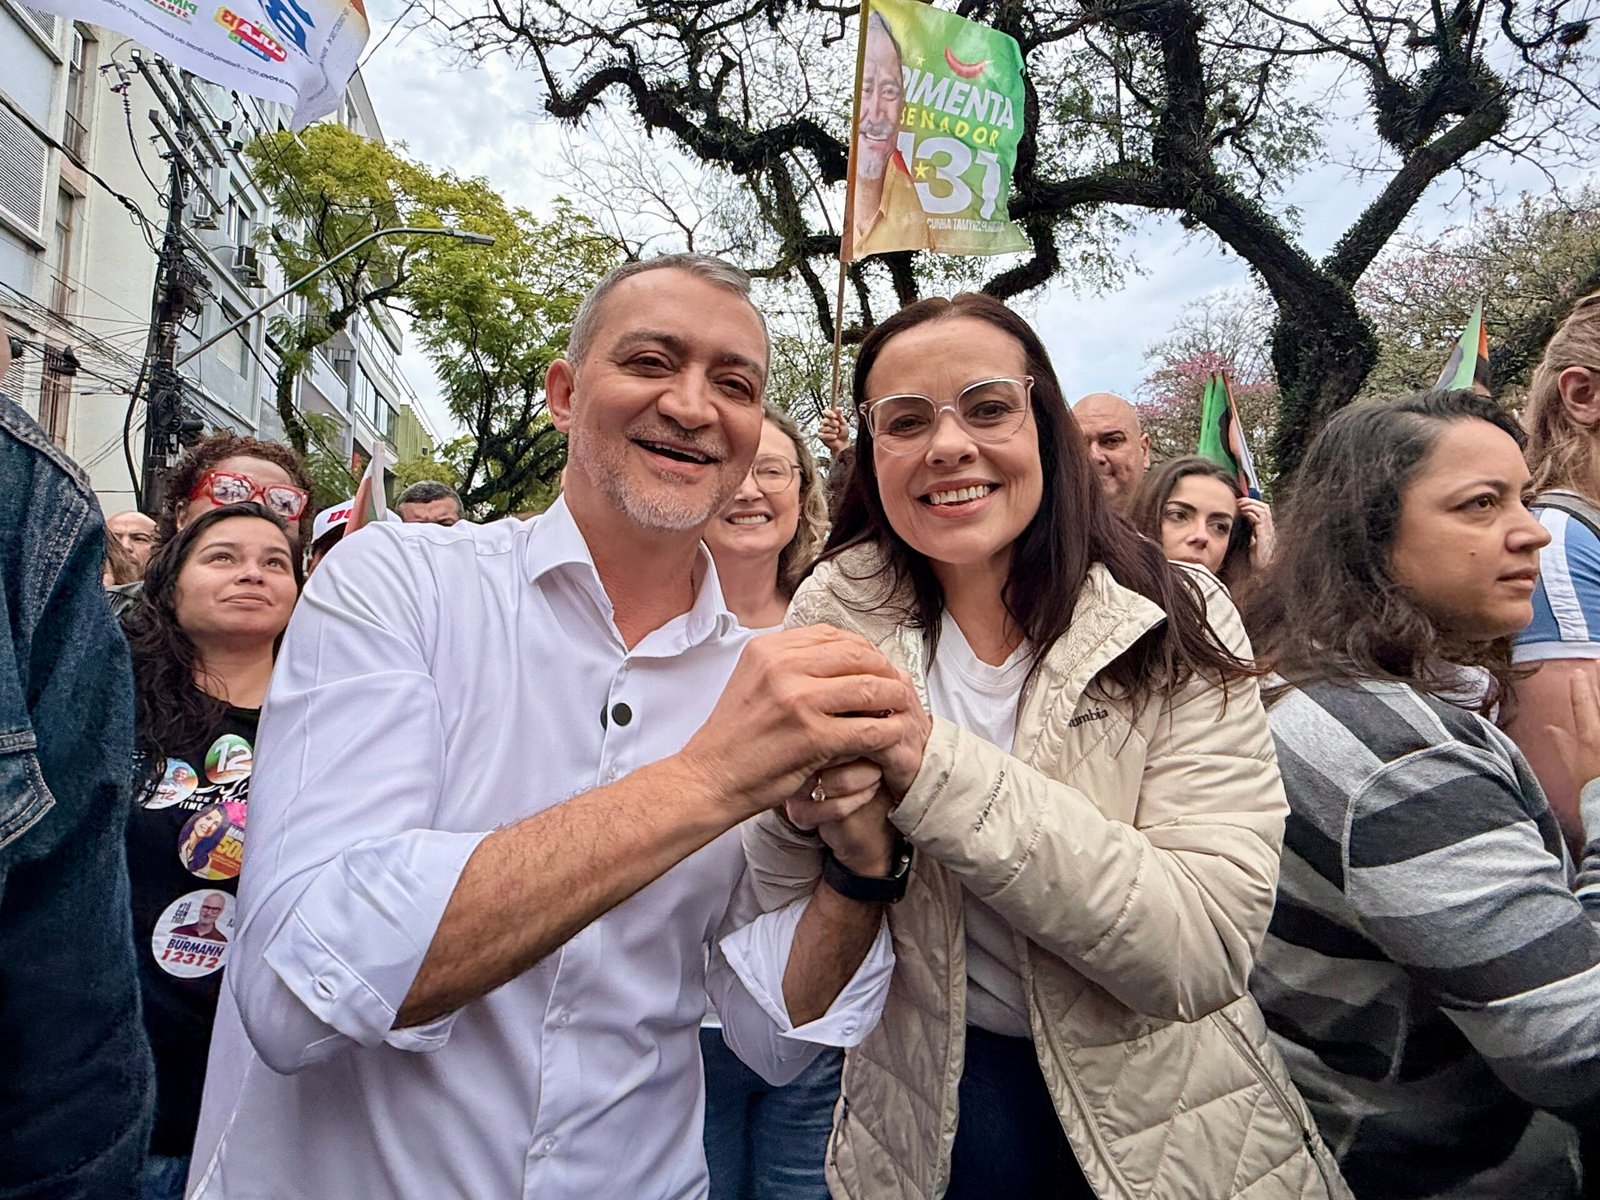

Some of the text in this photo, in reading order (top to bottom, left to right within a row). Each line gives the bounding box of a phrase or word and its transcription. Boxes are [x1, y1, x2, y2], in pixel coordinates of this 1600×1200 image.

[214, 742, 252, 774] 12
[974, 770, 1005, 834] OMNI-HEAT
[161, 949, 219, 969] 12312
[167, 938, 225, 957] BURMANN
